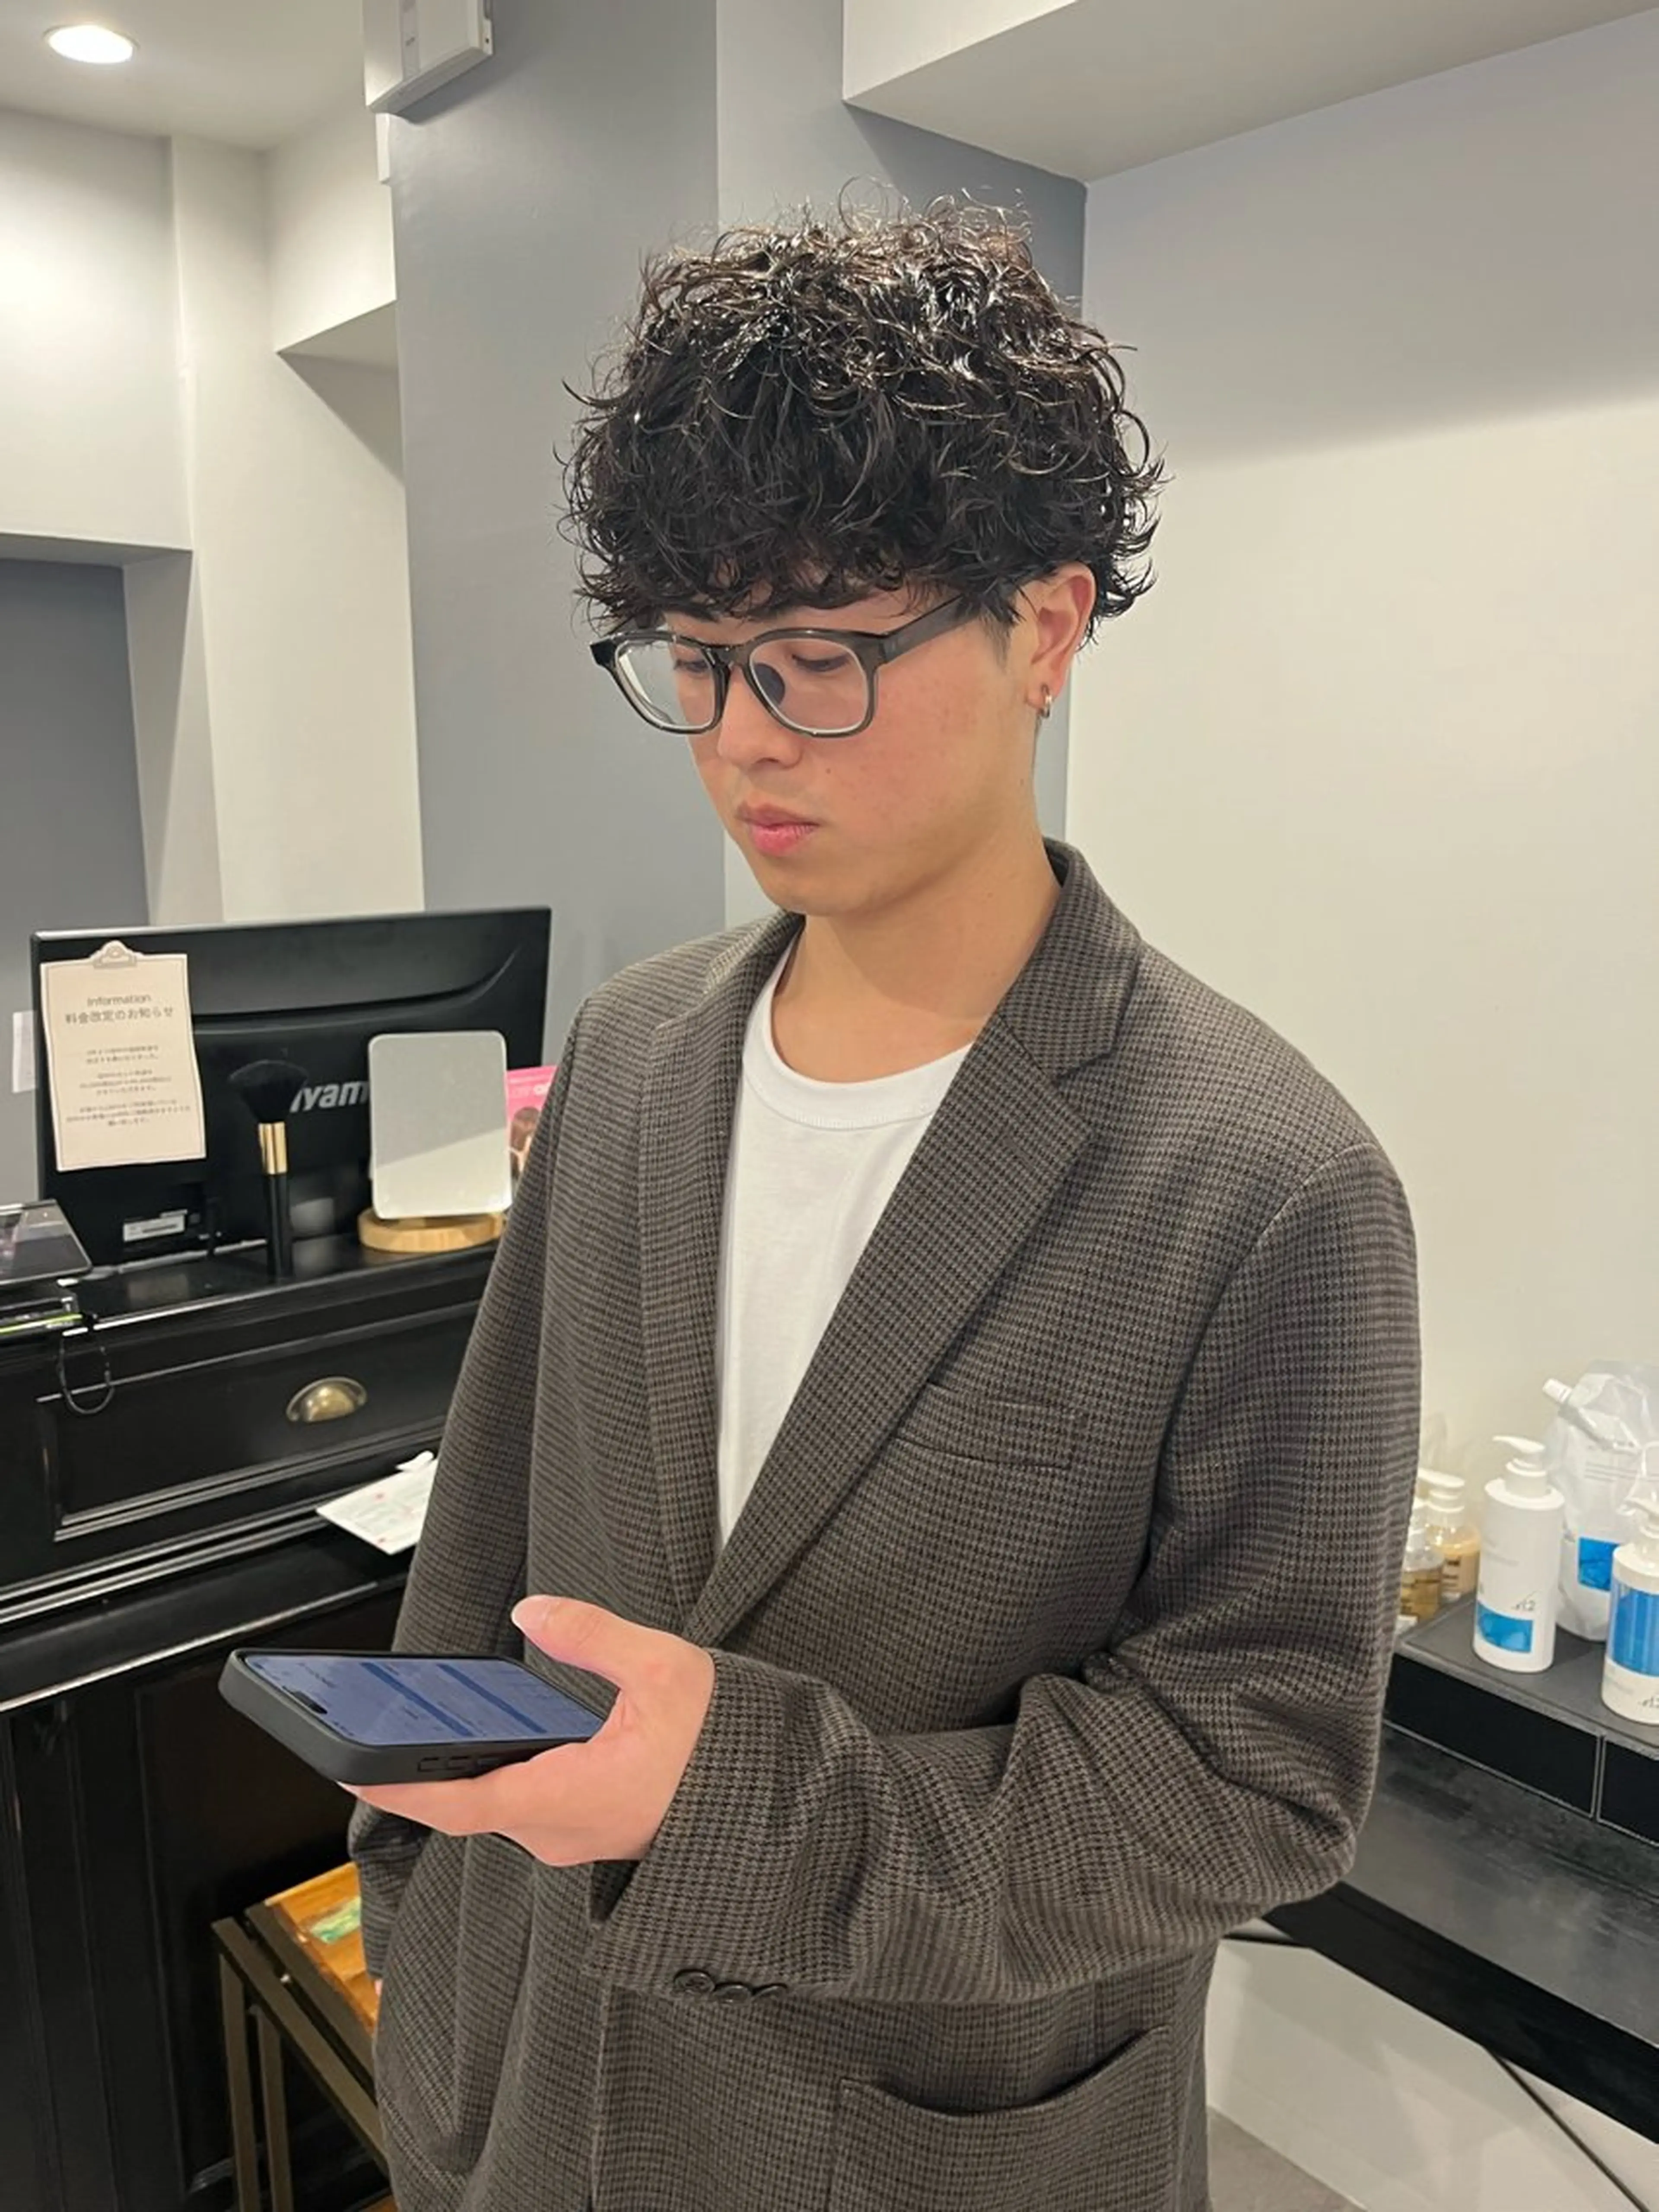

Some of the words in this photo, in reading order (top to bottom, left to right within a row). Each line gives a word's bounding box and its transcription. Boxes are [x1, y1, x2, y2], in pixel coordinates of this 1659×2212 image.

[87, 994, 152, 1007] Information
[65, 1007, 173, 1024] 料金改定のお知らせ
